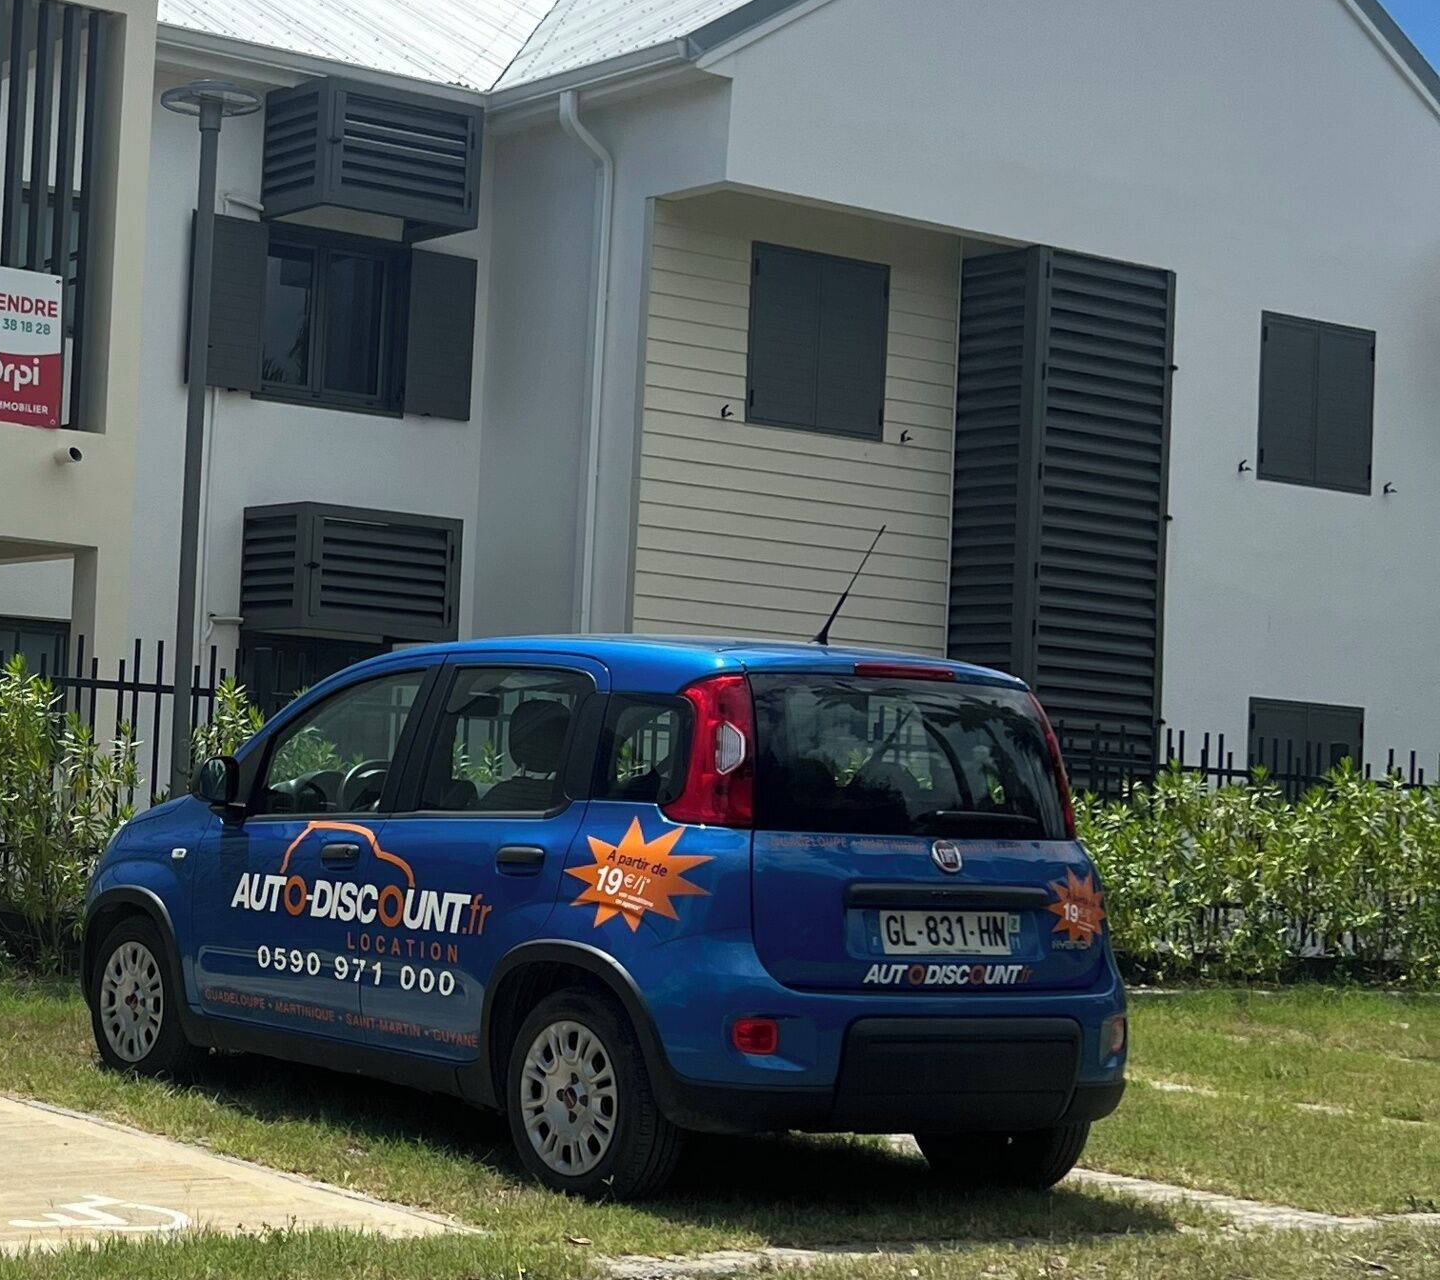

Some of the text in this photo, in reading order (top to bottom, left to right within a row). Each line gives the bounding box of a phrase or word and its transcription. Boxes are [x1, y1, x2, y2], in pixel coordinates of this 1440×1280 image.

[2, 318, 18, 331] 38
[21, 320, 33, 333] 18
[35, 322, 51, 335] 28
[617, 853, 650, 871] partir
[651, 863, 668, 877] de
[231, 872, 492, 936] AUTO-DISCOUNT.fr
[886, 915, 1007, 946] GL-831-HN
[347, 932, 459, 964] LOCATION
[257, 945, 456, 996] 0590 971 000
[205, 988, 479, 1049] GUADELOUPE MARTINIQUE SAINT-MARTIN GUYANE
